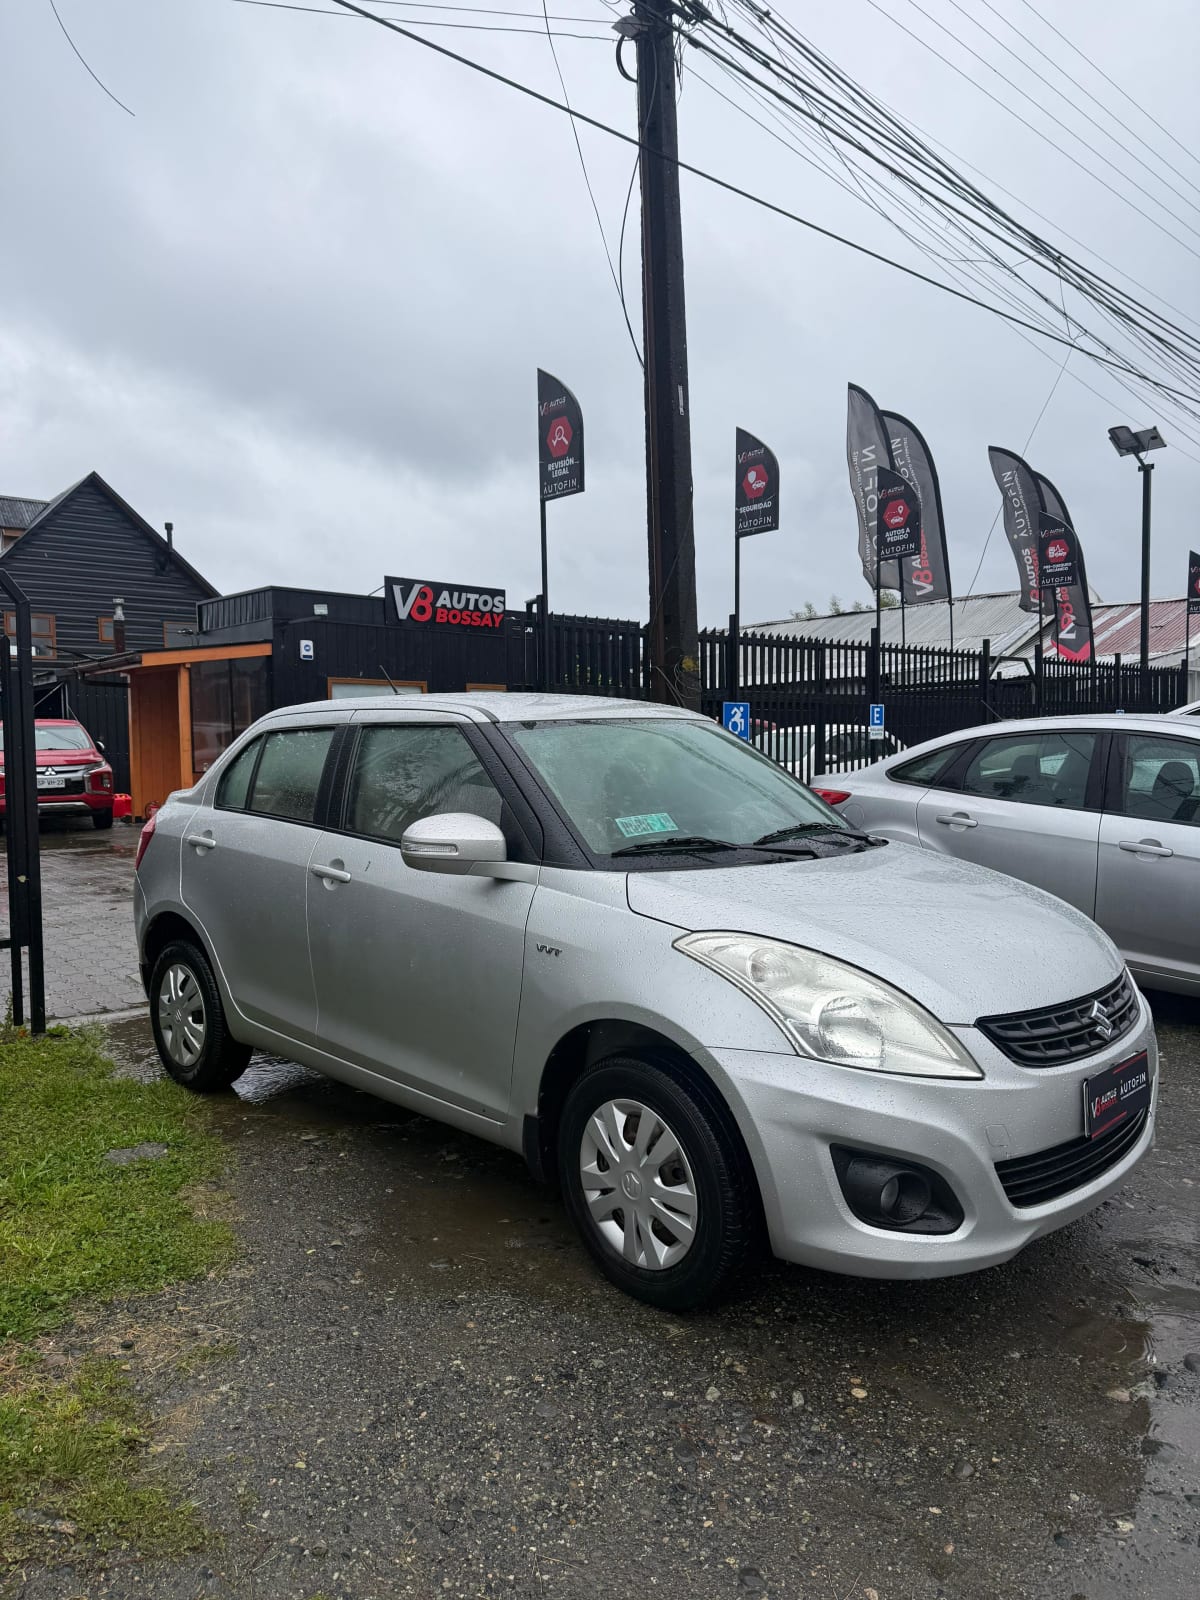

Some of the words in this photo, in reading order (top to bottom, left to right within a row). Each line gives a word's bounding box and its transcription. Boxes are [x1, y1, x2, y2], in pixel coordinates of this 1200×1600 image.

[547, 456, 574, 472] REVISIÓN
[552, 466, 570, 478] LEGAL
[543, 478, 577, 494] AUTOFIN
[739, 501, 772, 514] SEGURIDAD
[1001, 470, 1029, 539] AUTOFIN
[738, 516, 772, 529] AUTOFIN
[885, 529, 905, 538] AUTOS
[887, 533, 909, 543] PEDIDO
[880, 543, 915, 556] AUTOFIN
[1021, 548, 1037, 588] AUTOS
[912, 569, 934, 596] V8
[1041, 575, 1073, 585] AUTOFIN
[392, 583, 434, 622] V8
[435, 590, 505, 613] AUTOS
[435, 607, 504, 628] BOSSAY
[873, 707, 881, 724] E
[1120, 1072, 1146, 1096] AUTOFIN
